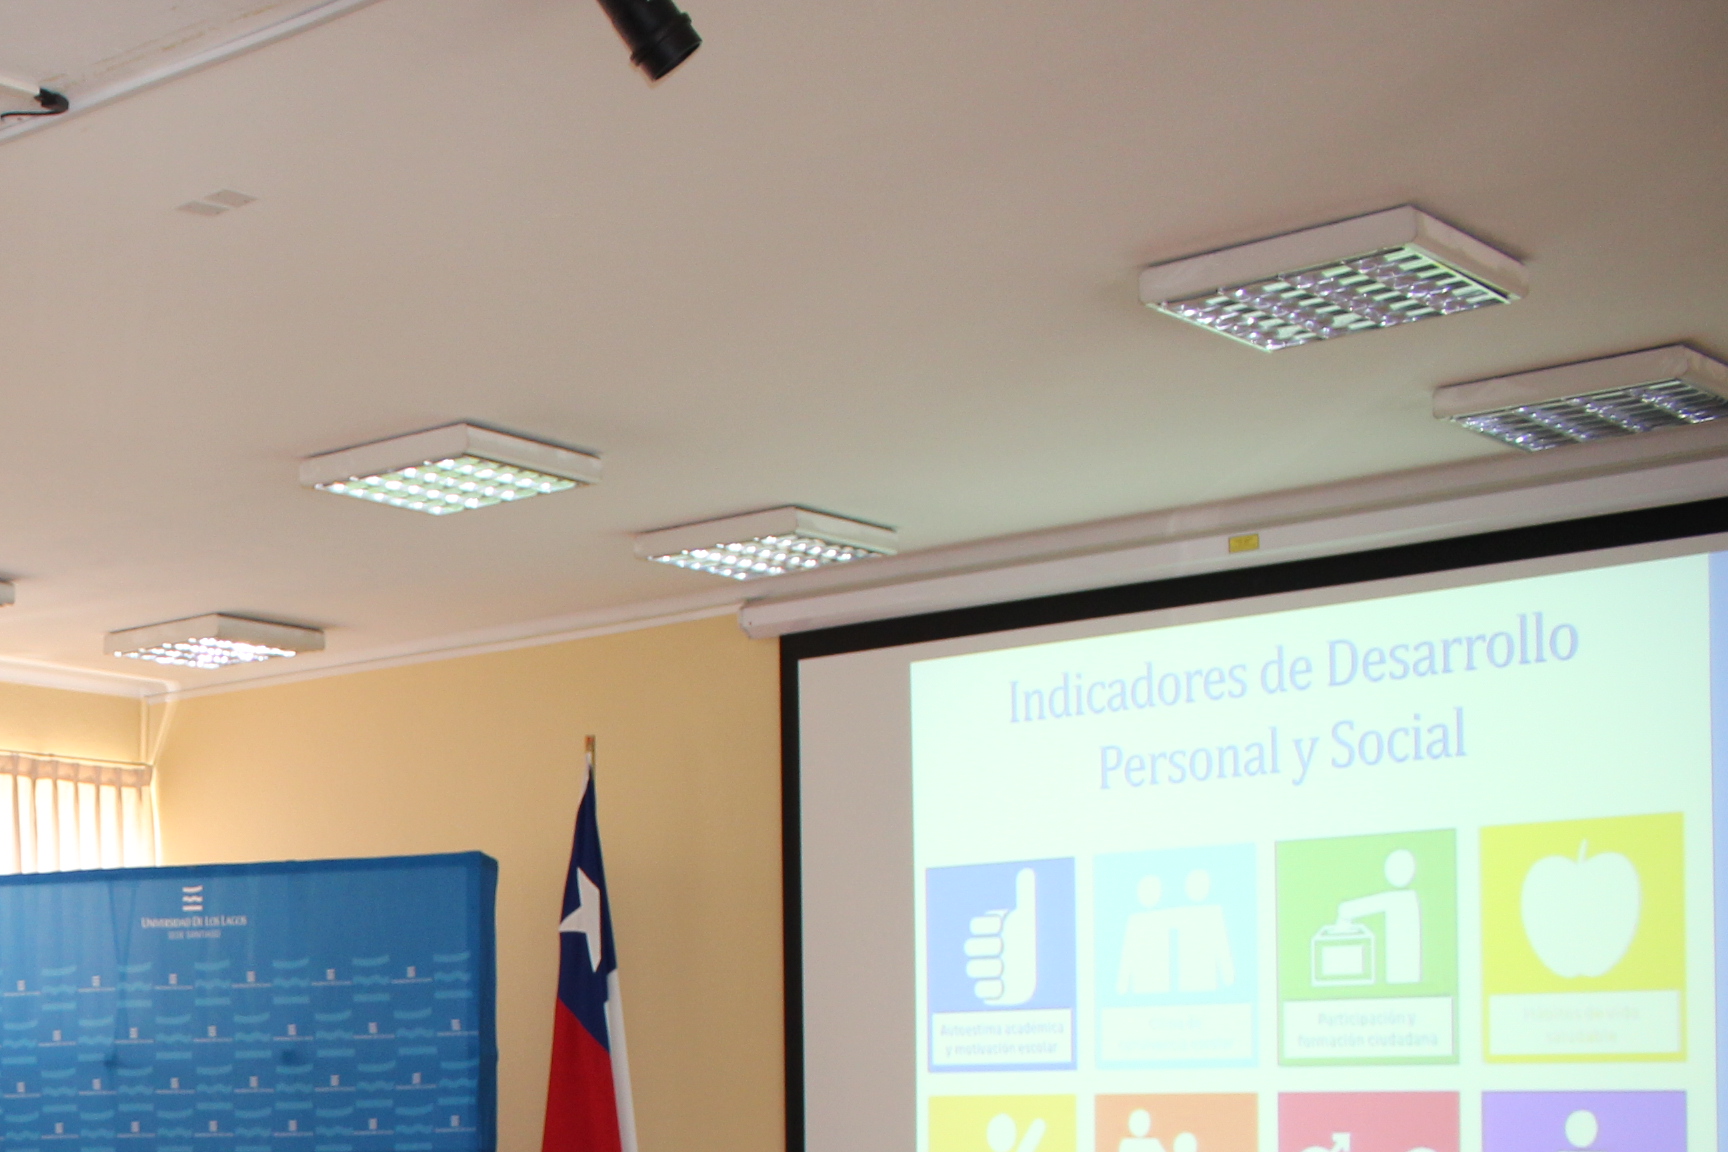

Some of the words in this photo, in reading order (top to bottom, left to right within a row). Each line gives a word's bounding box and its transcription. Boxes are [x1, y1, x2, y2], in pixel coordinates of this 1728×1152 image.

[1009, 661, 1248, 723] Indicadores
[1260, 644, 1313, 694] de
[1327, 611, 1580, 687] Desarrollo
[1100, 726, 1281, 790] Personal
[1292, 736, 1320, 787] y
[1330, 706, 1468, 769] Social
